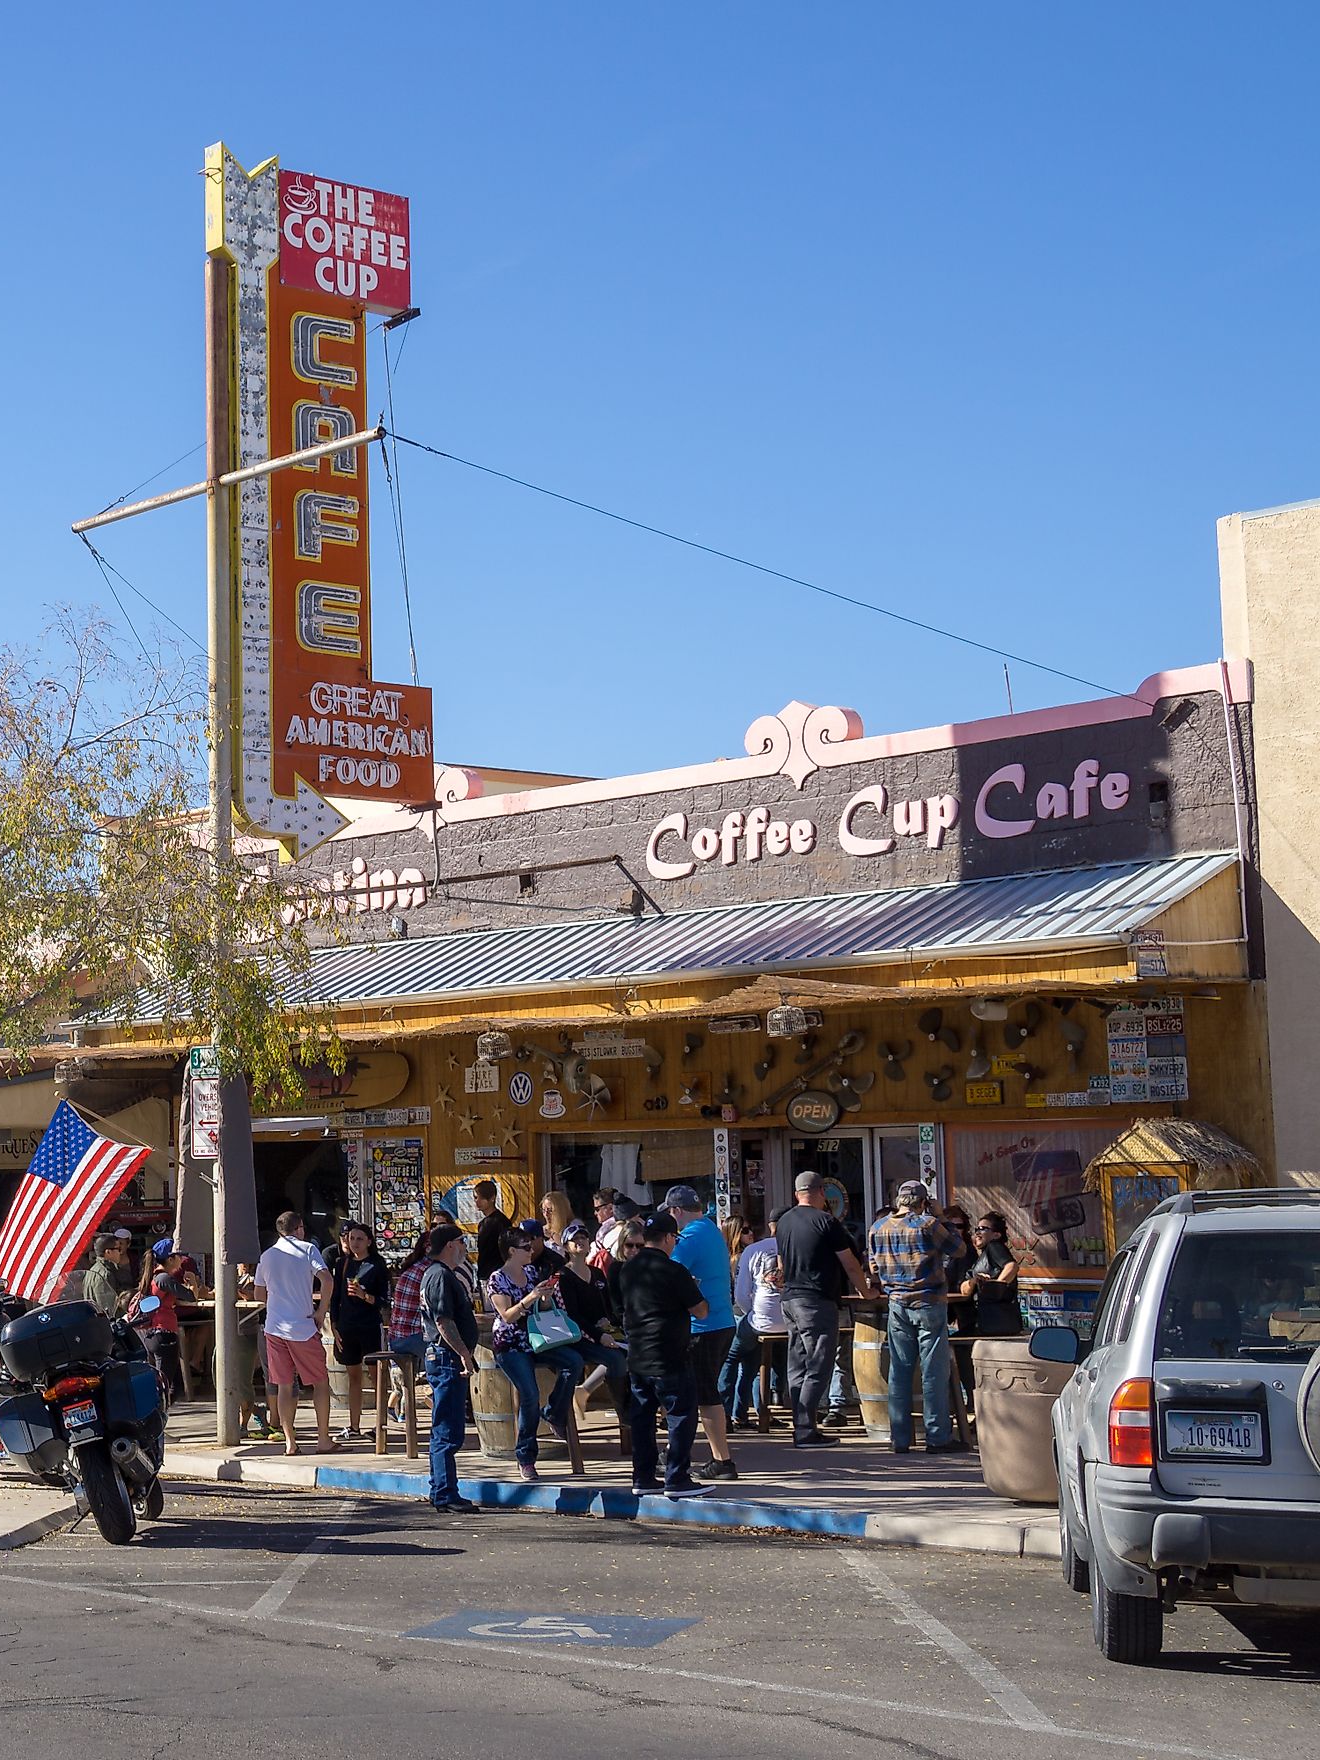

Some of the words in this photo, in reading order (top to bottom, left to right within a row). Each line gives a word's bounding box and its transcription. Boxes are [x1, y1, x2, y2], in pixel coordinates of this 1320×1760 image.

[314, 180, 376, 227] THE
[283, 212, 408, 271] COFFEE
[315, 256, 379, 299] CUP
[289, 311, 361, 659] CAFE
[309, 681, 405, 722] GREAT
[285, 714, 431, 758] AMERICAN
[318, 753, 401, 789] FOOD
[645, 806, 817, 880] Coffee
[838, 784, 959, 858] Cup
[973, 758, 1131, 839] Cafe
[792, 1104, 831, 1119] OPEN
[818, 1140, 839, 1152] 512
